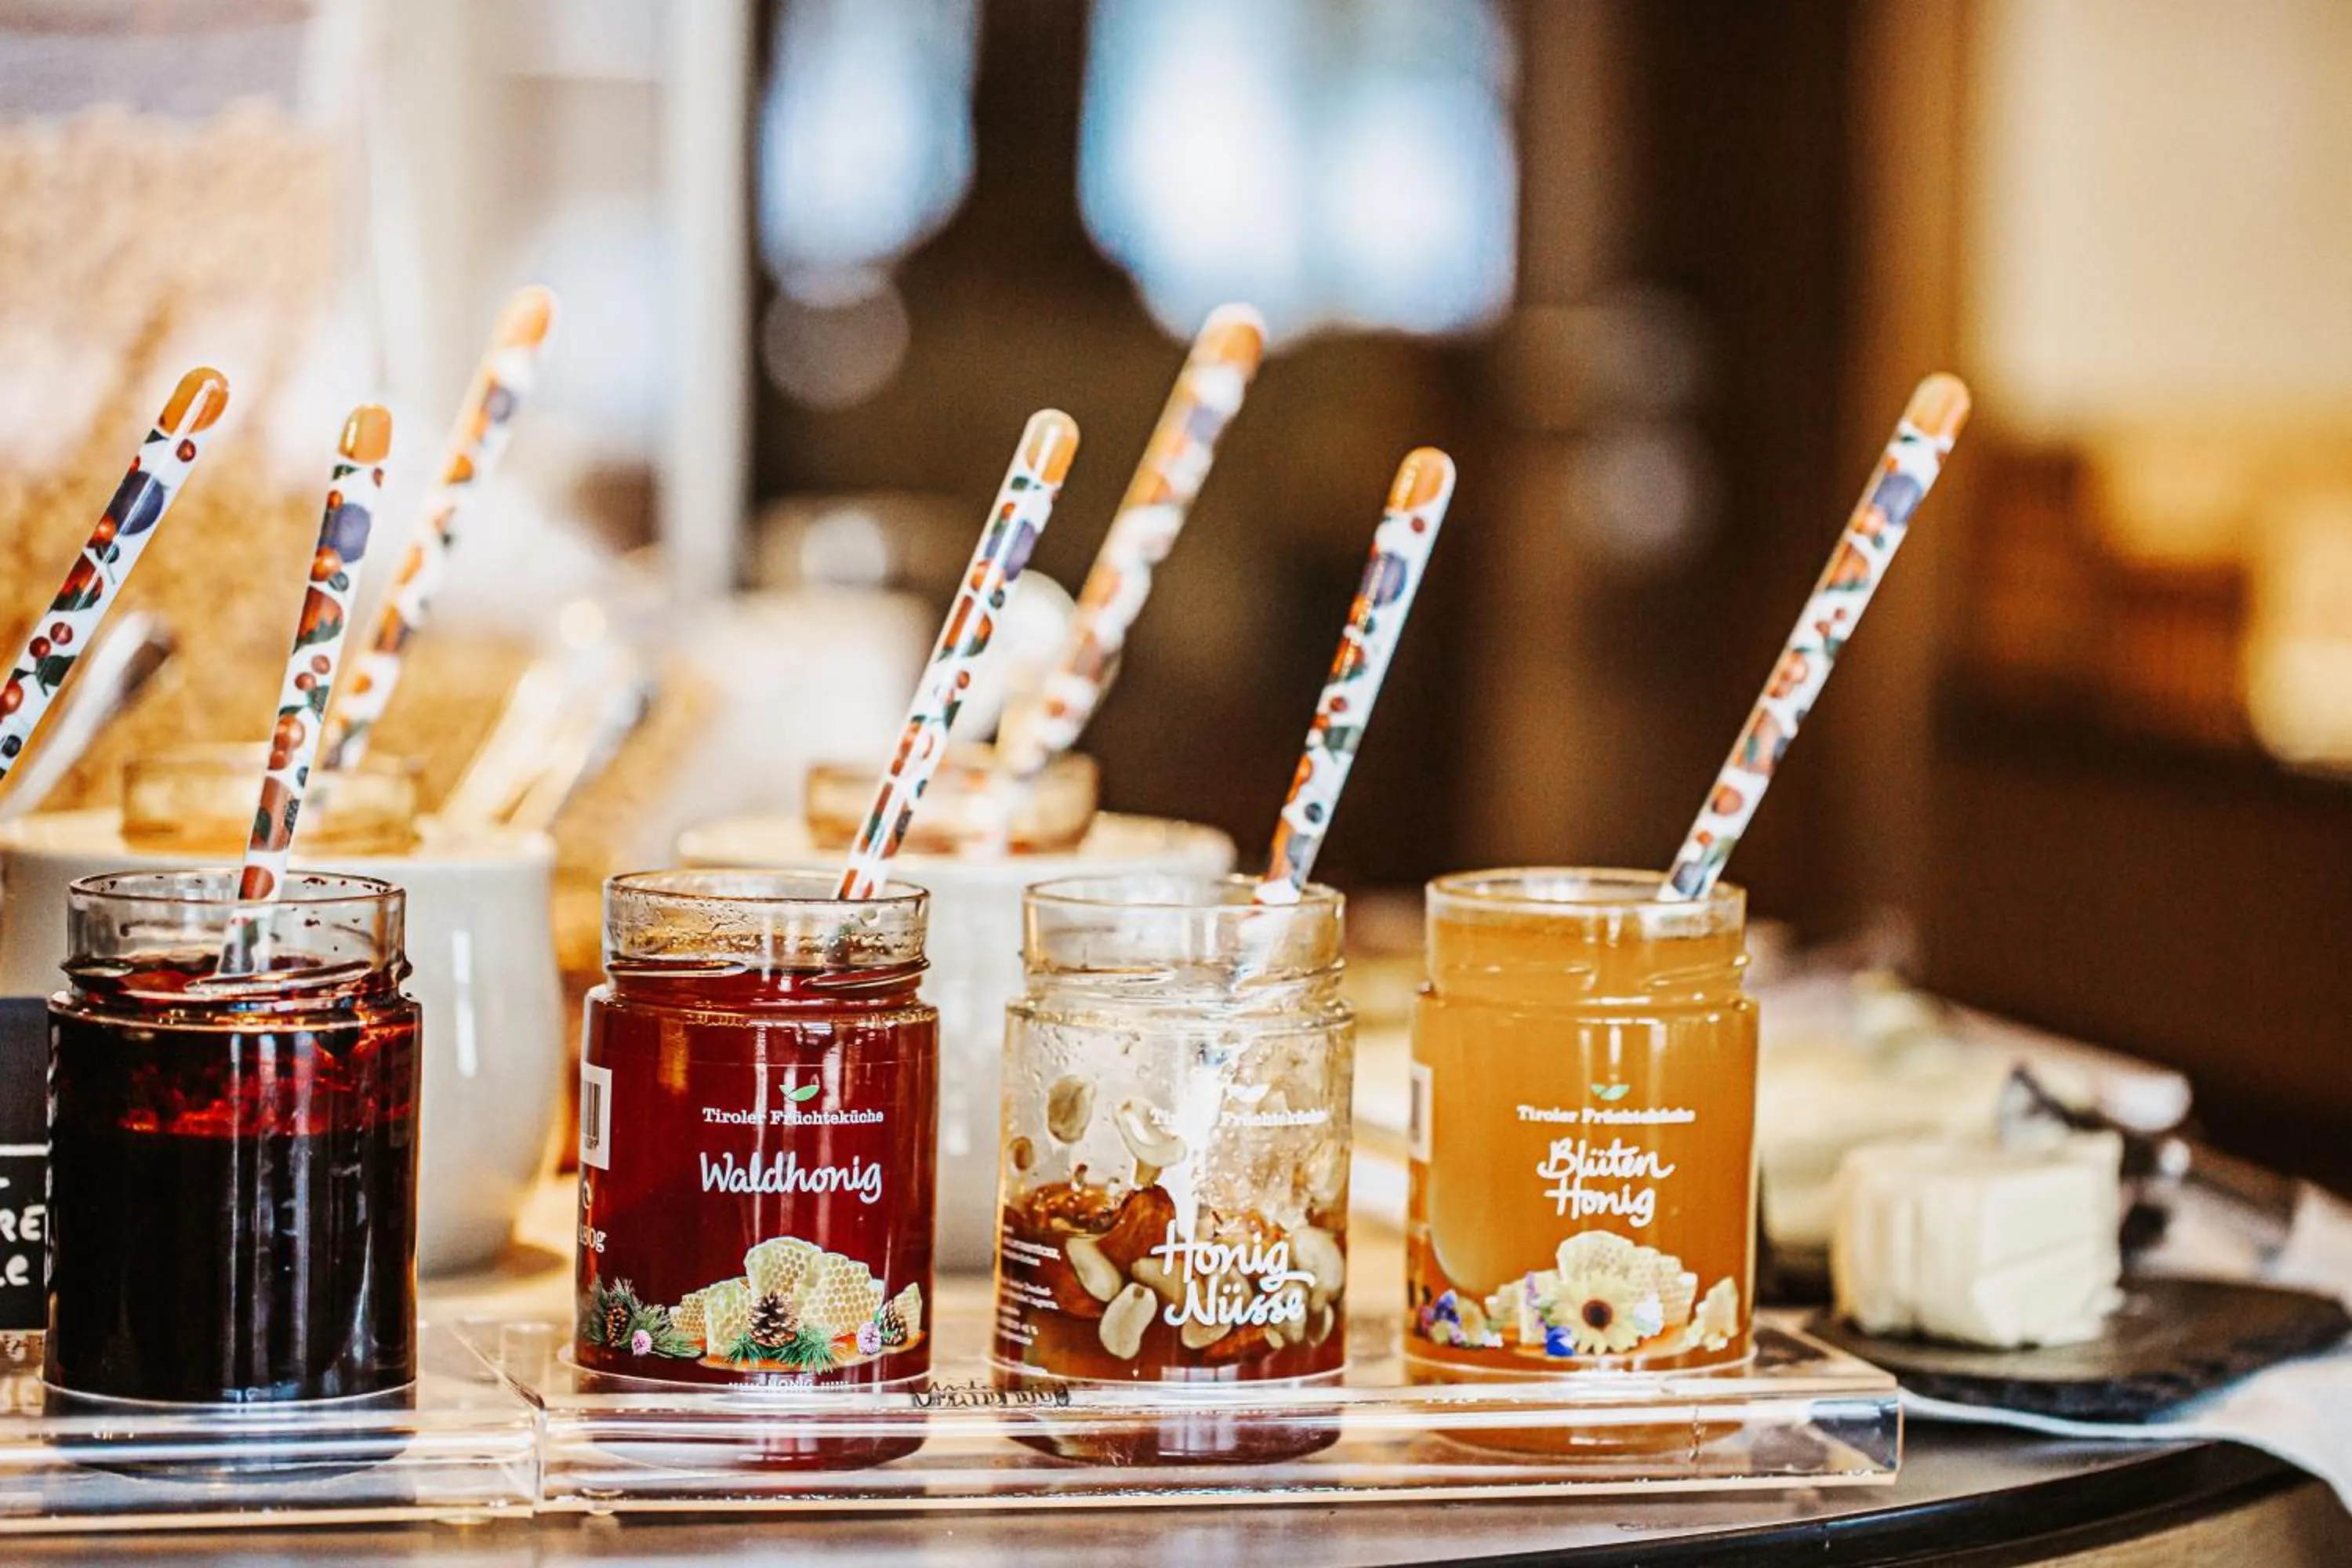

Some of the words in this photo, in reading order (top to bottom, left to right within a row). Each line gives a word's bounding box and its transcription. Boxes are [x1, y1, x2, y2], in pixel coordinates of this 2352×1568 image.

[702, 1107, 766, 1124] Tiroler
[770, 1109, 884, 1125] Früchteküche
[700, 1152, 882, 1204] Waldhonig
[1537, 1137, 1676, 1179] Blüten
[1544, 1176, 1656, 1227] Honig
[1150, 1219, 1316, 1292] Honig
[1163, 1275, 1305, 1326] Nüsse
